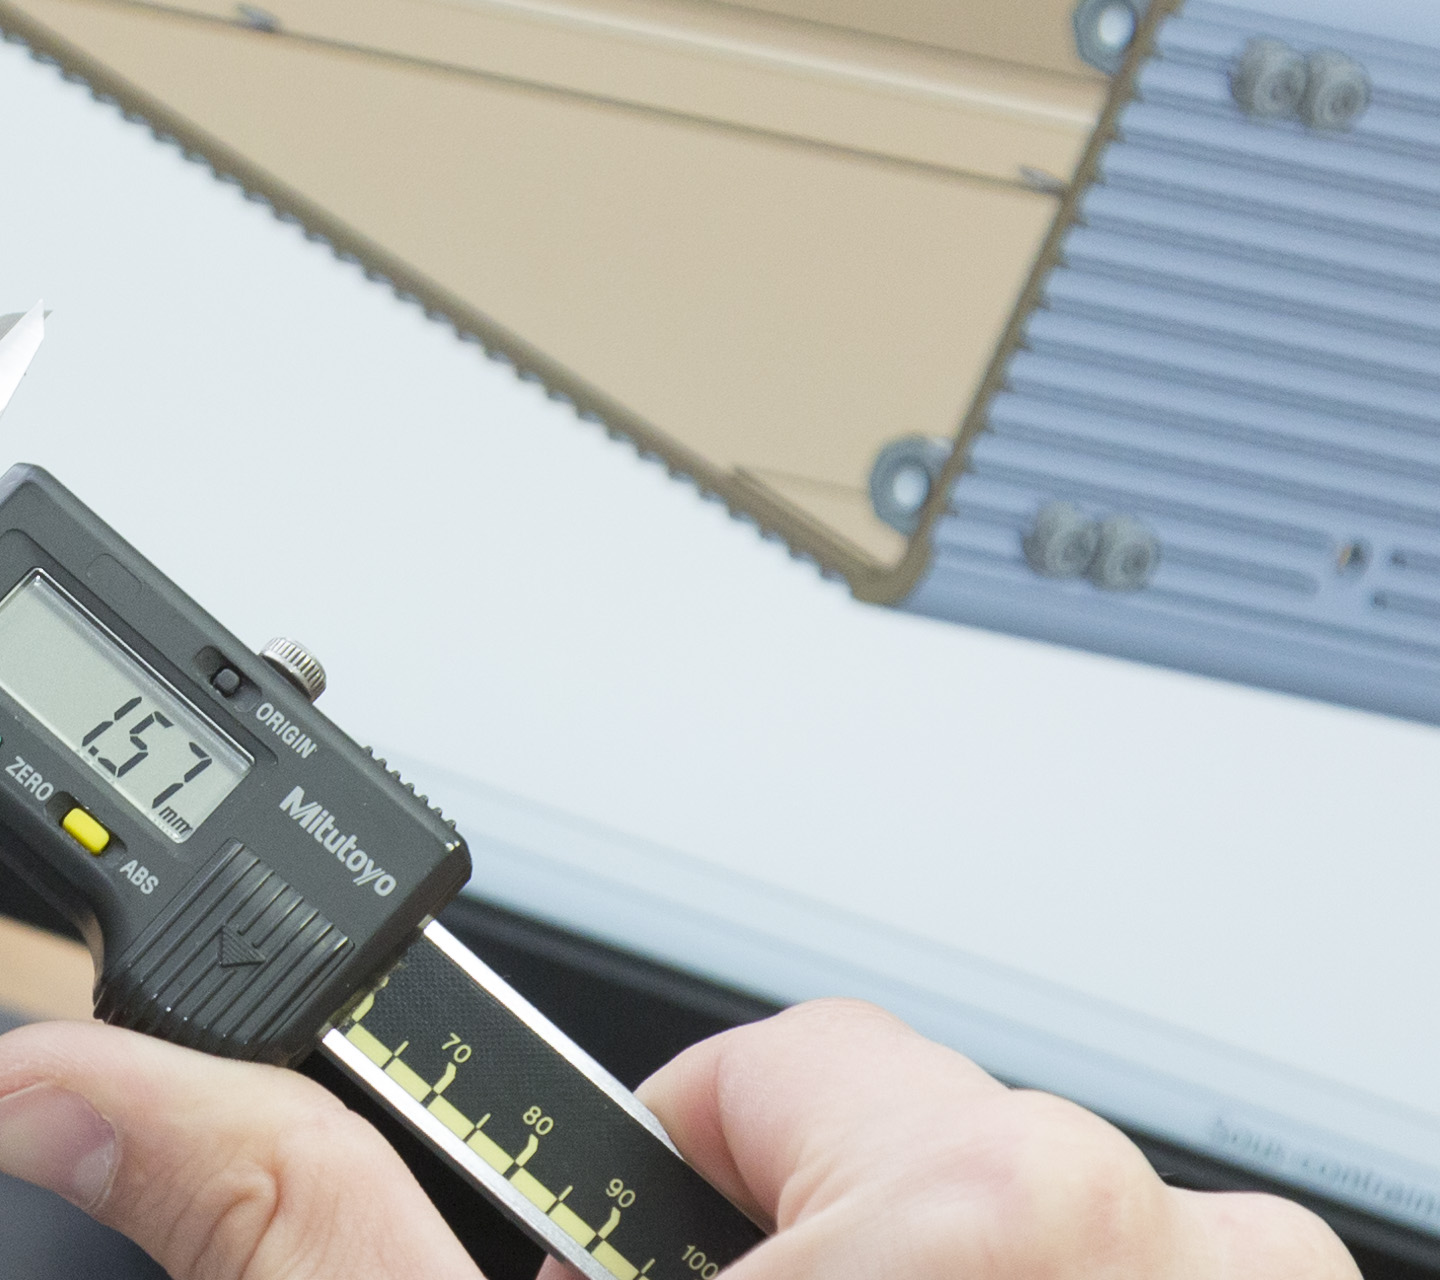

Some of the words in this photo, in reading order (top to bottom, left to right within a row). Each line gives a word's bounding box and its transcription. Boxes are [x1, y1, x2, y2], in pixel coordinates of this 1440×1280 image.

[255, 702, 318, 758] ORIGIN
[82, 696, 213, 809] 1.57
[4, 756, 54, 802] ZERO
[279, 786, 397, 897] Mitutoyo
[119, 858, 159, 894] ABS
[441, 1032, 472, 1064] 70
[522, 1105, 554, 1136] 80
[605, 1178, 636, 1209] 90
[680, 1245, 719, 1280] 100
